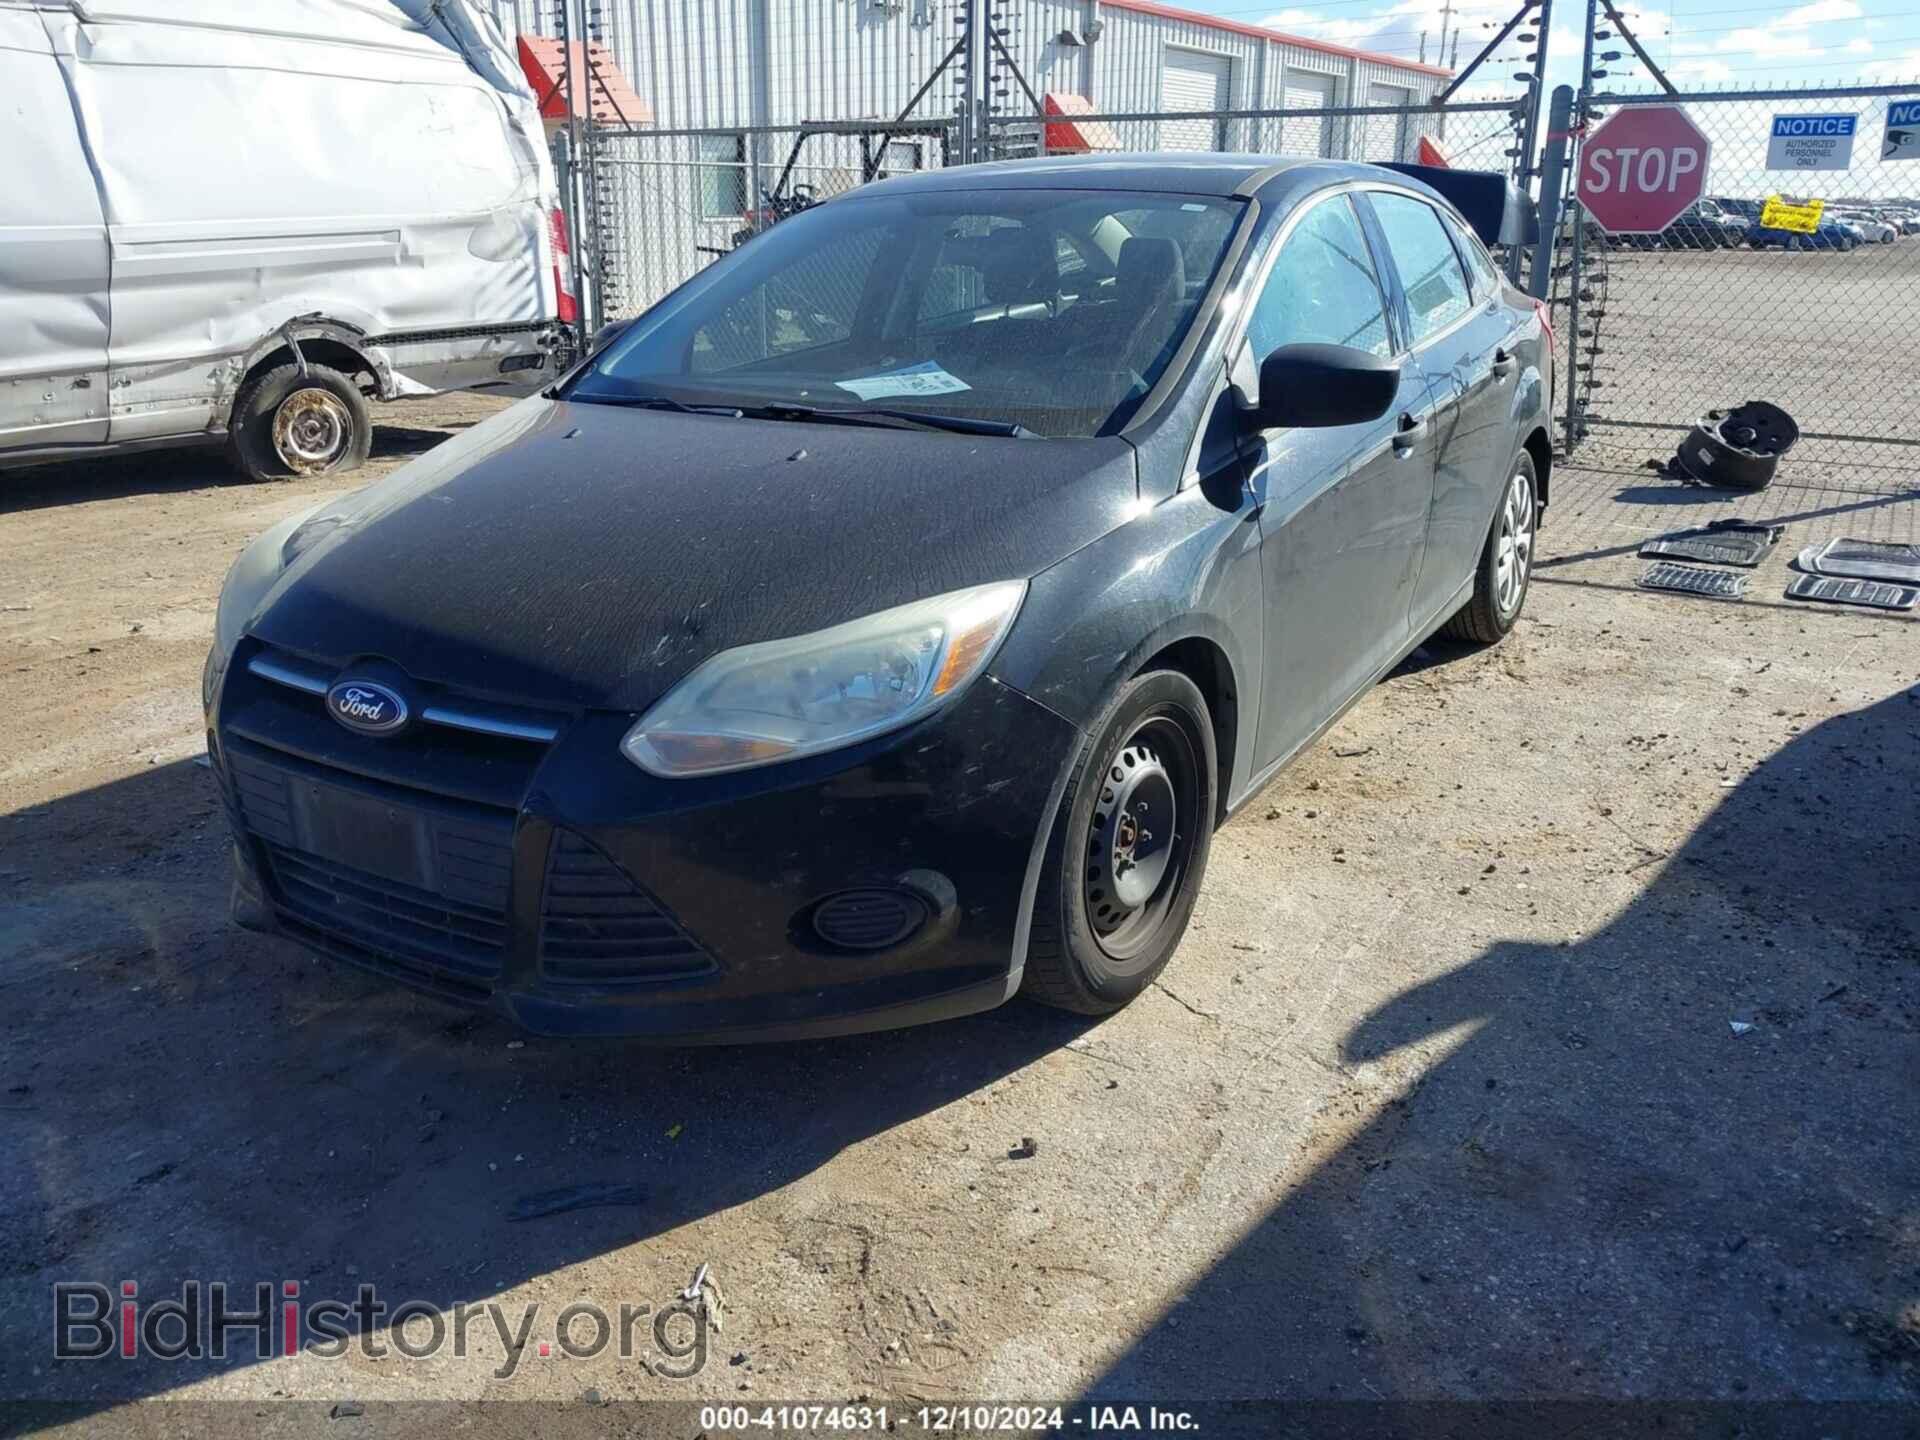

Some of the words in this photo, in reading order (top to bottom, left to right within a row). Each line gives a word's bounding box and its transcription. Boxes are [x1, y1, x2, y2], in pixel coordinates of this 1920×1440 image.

[1777, 118, 1851, 135] NOTICE
[1785, 139, 1837, 149] AUTHORIZED
[1785, 149, 1833, 158] PERSONNEL
[1796, 158, 1818, 167] ONLY
[1585, 146, 1699, 194] STOP
[340, 687, 385, 721] Ford
